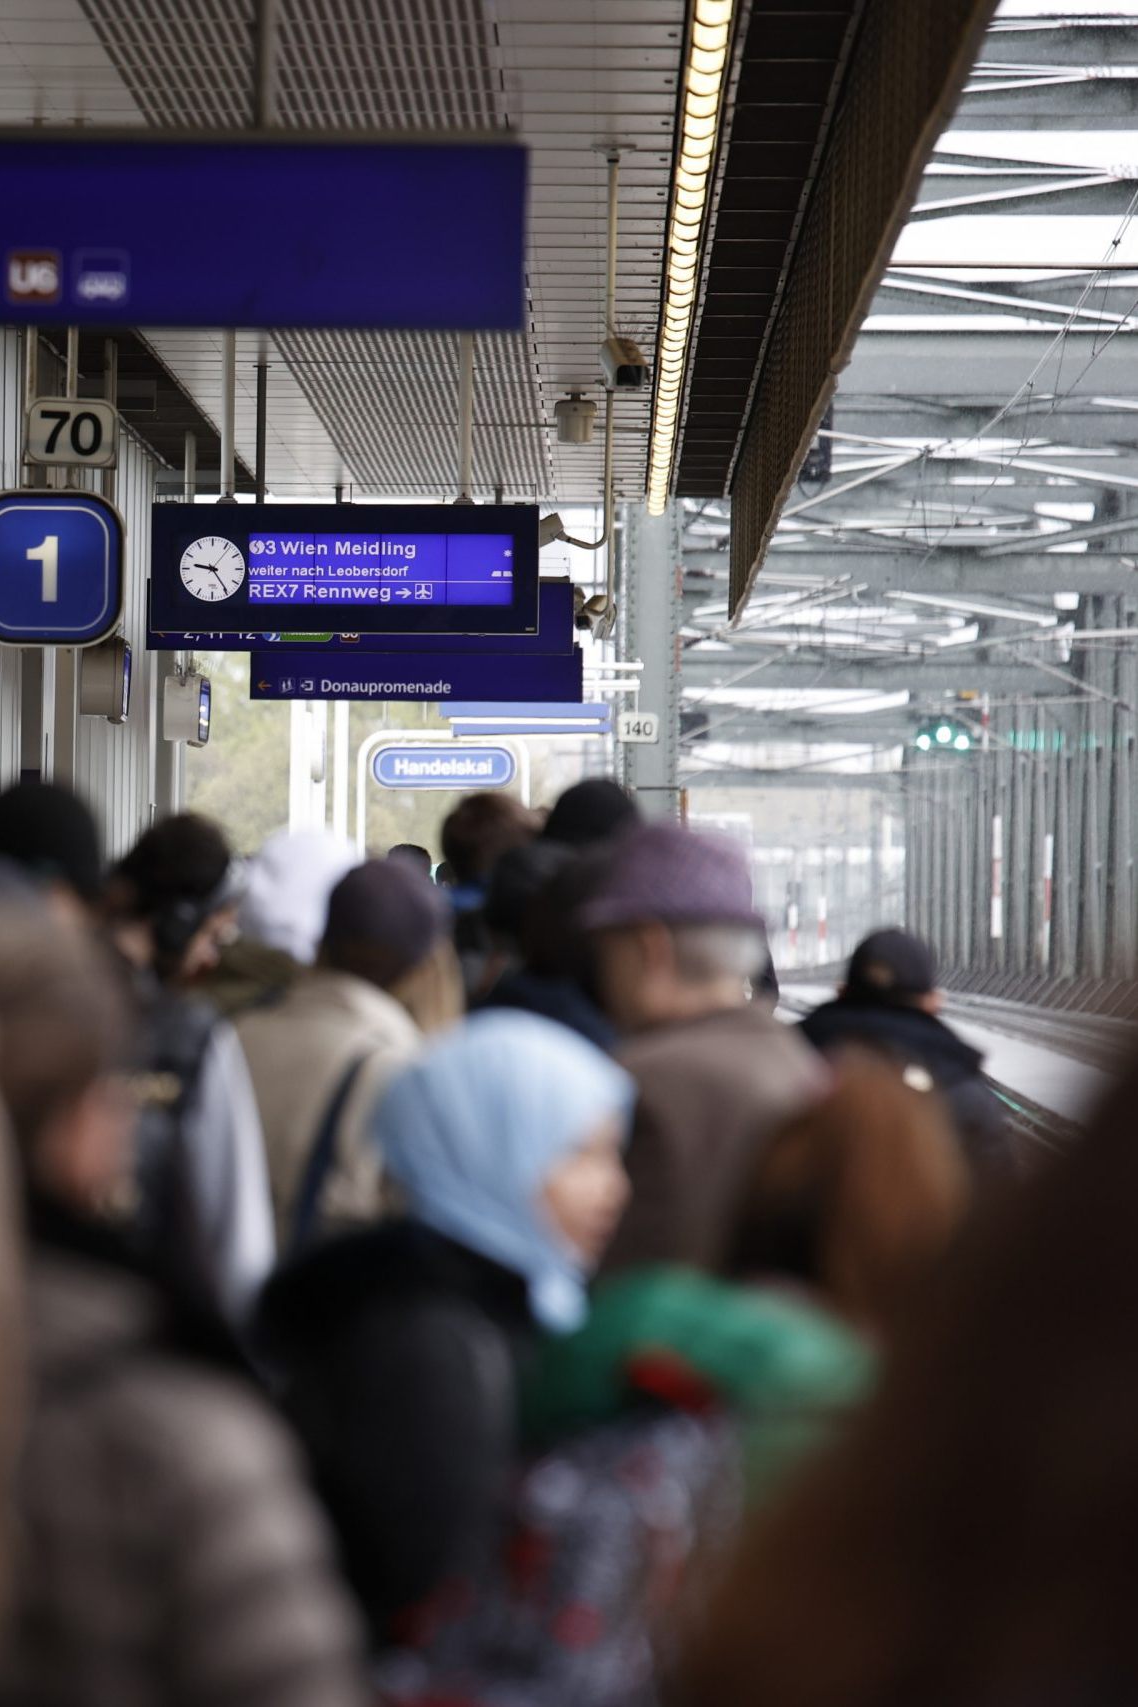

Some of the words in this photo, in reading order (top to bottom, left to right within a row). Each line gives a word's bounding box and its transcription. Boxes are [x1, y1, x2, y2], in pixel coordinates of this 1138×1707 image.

[8, 259, 59, 295] U6
[40, 410, 102, 456] 70
[280, 541, 328, 556] Wien
[335, 541, 417, 559] Meidling
[26, 535, 59, 602] 1
[248, 565, 288, 577] weiter
[291, 565, 324, 577] nach
[328, 565, 410, 577] Leobersdorf
[249, 584, 299, 598] REX7
[304, 584, 391, 602] Rennweg
[320, 679, 452, 696] Donaupromenade
[623, 720, 654, 736] 140
[393, 757, 494, 777] Handelskai
